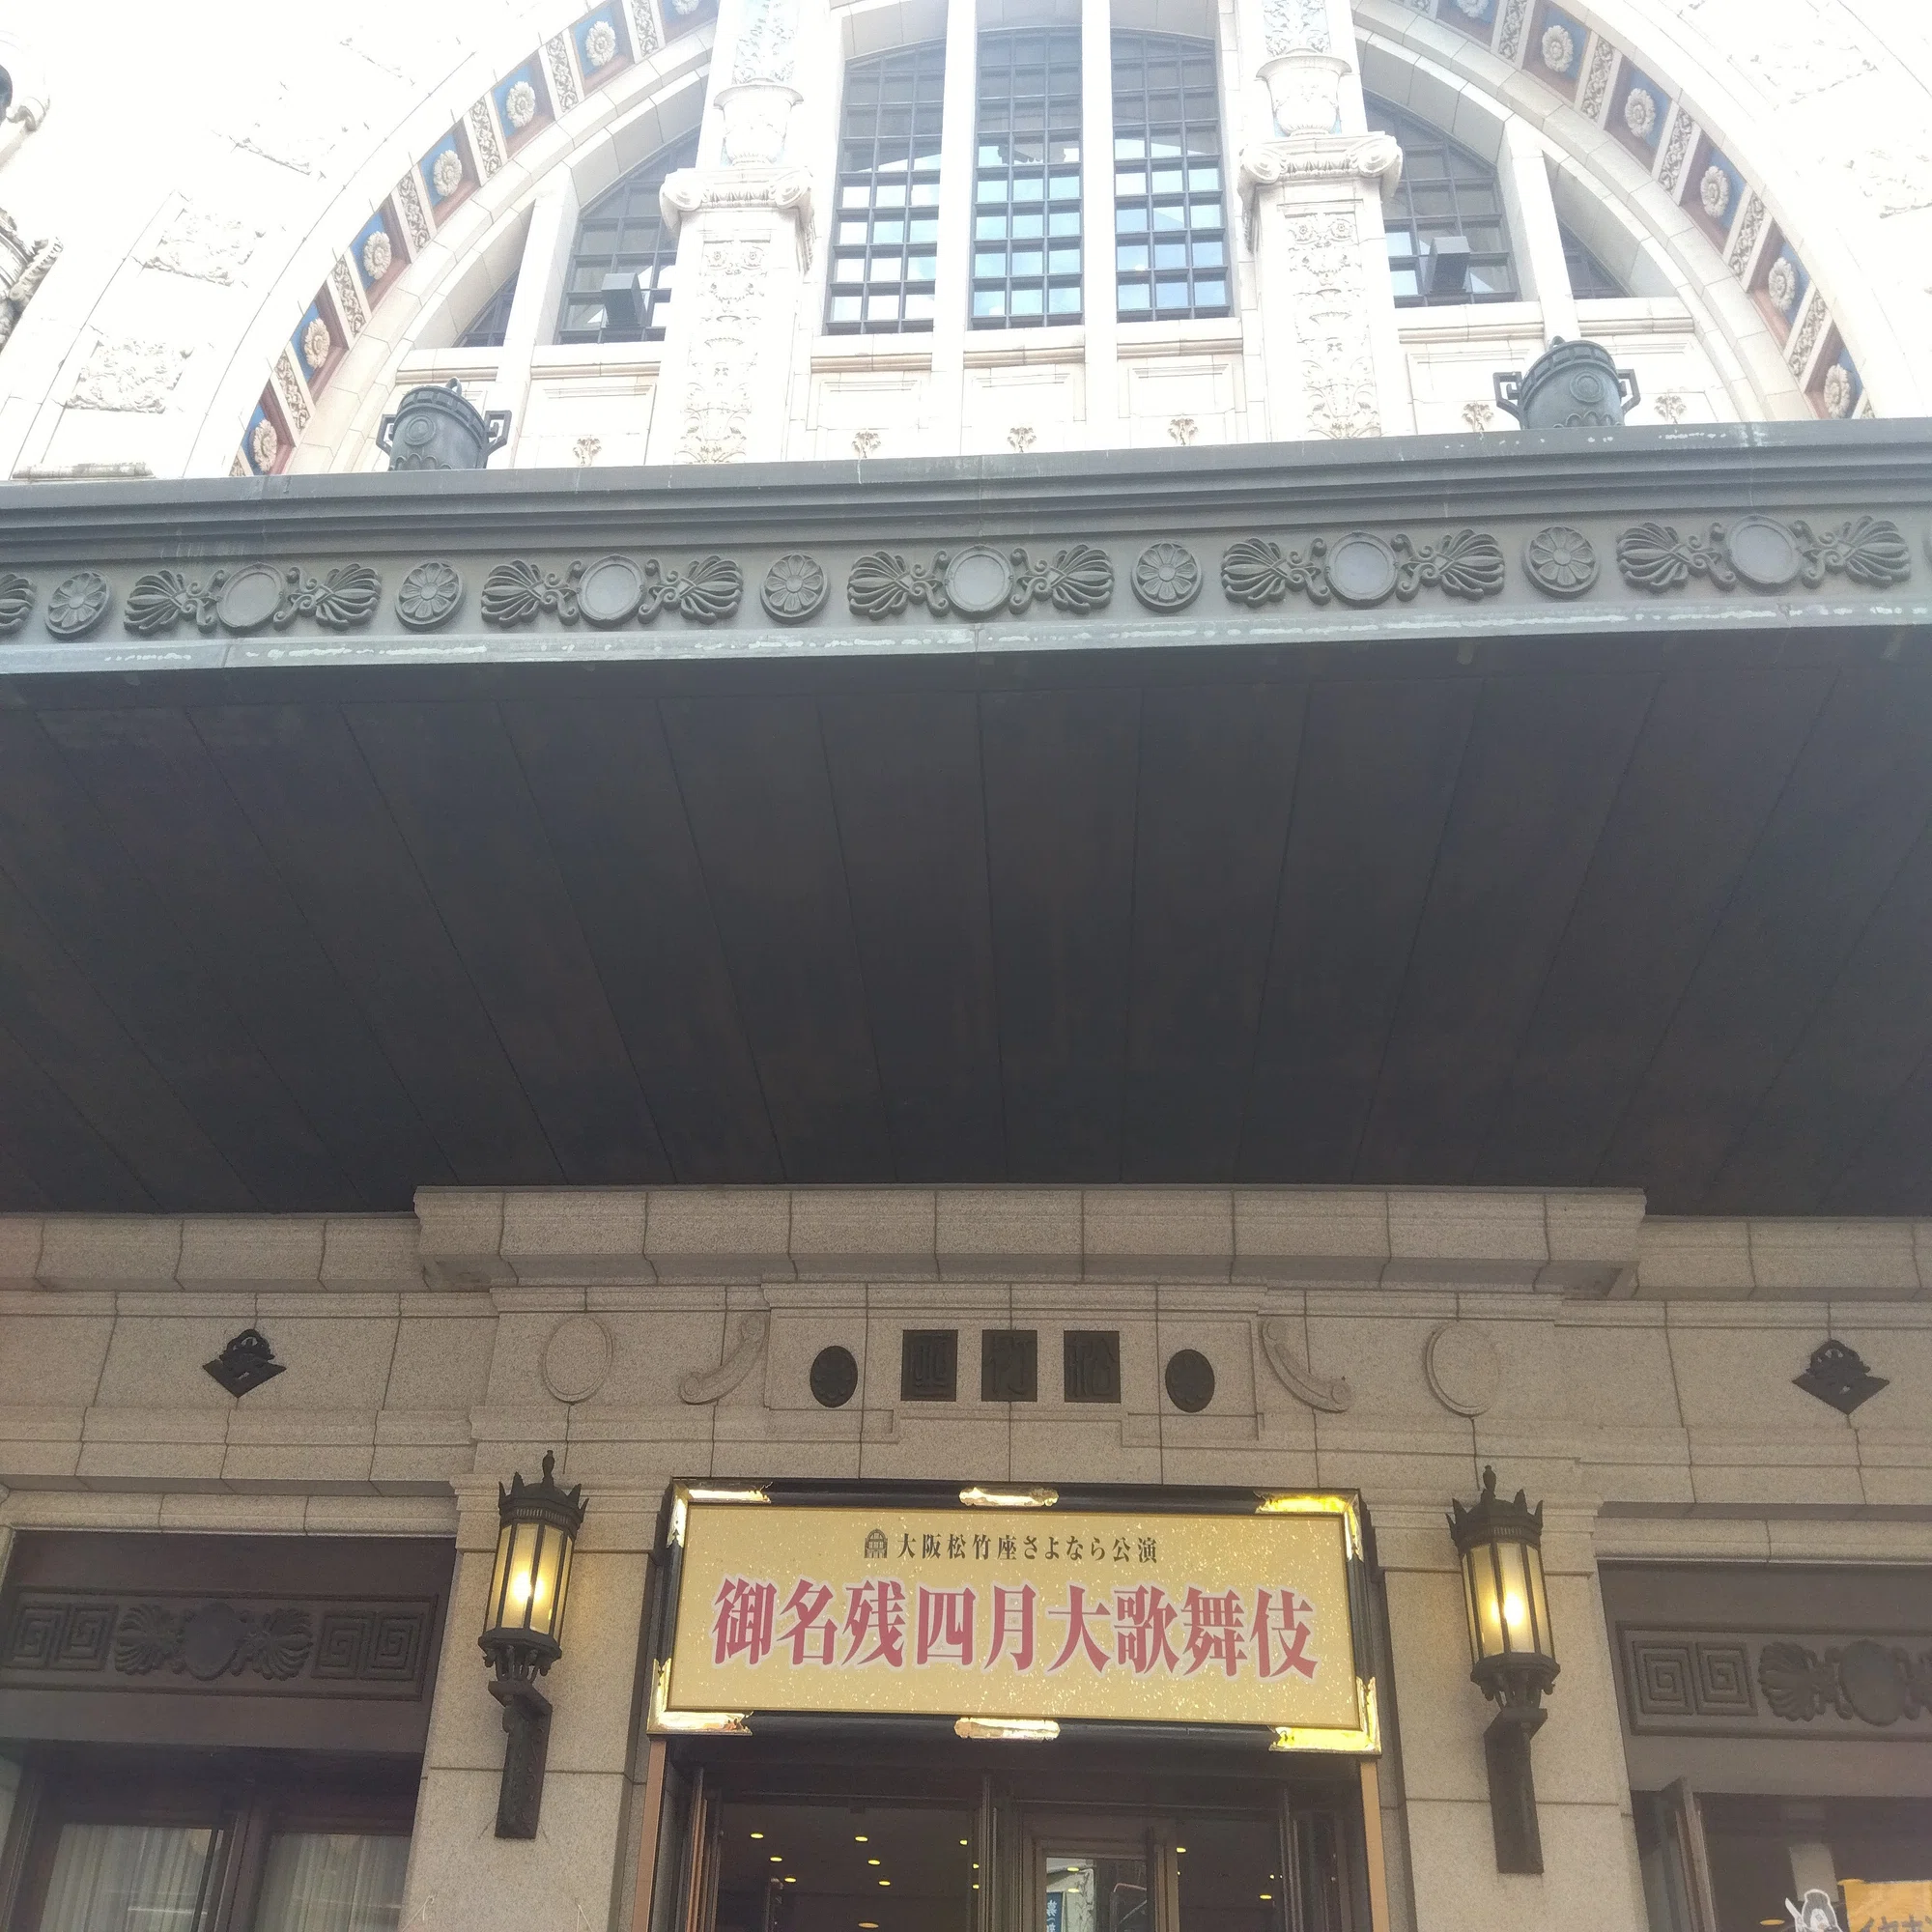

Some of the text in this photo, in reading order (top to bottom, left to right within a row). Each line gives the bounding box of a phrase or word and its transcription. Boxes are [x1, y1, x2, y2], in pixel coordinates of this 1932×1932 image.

[897, 1532, 1157, 1563] 大阪松竹座さよなら公演
[713, 1577, 1317, 1679] 御名残四月大歌舞伎
